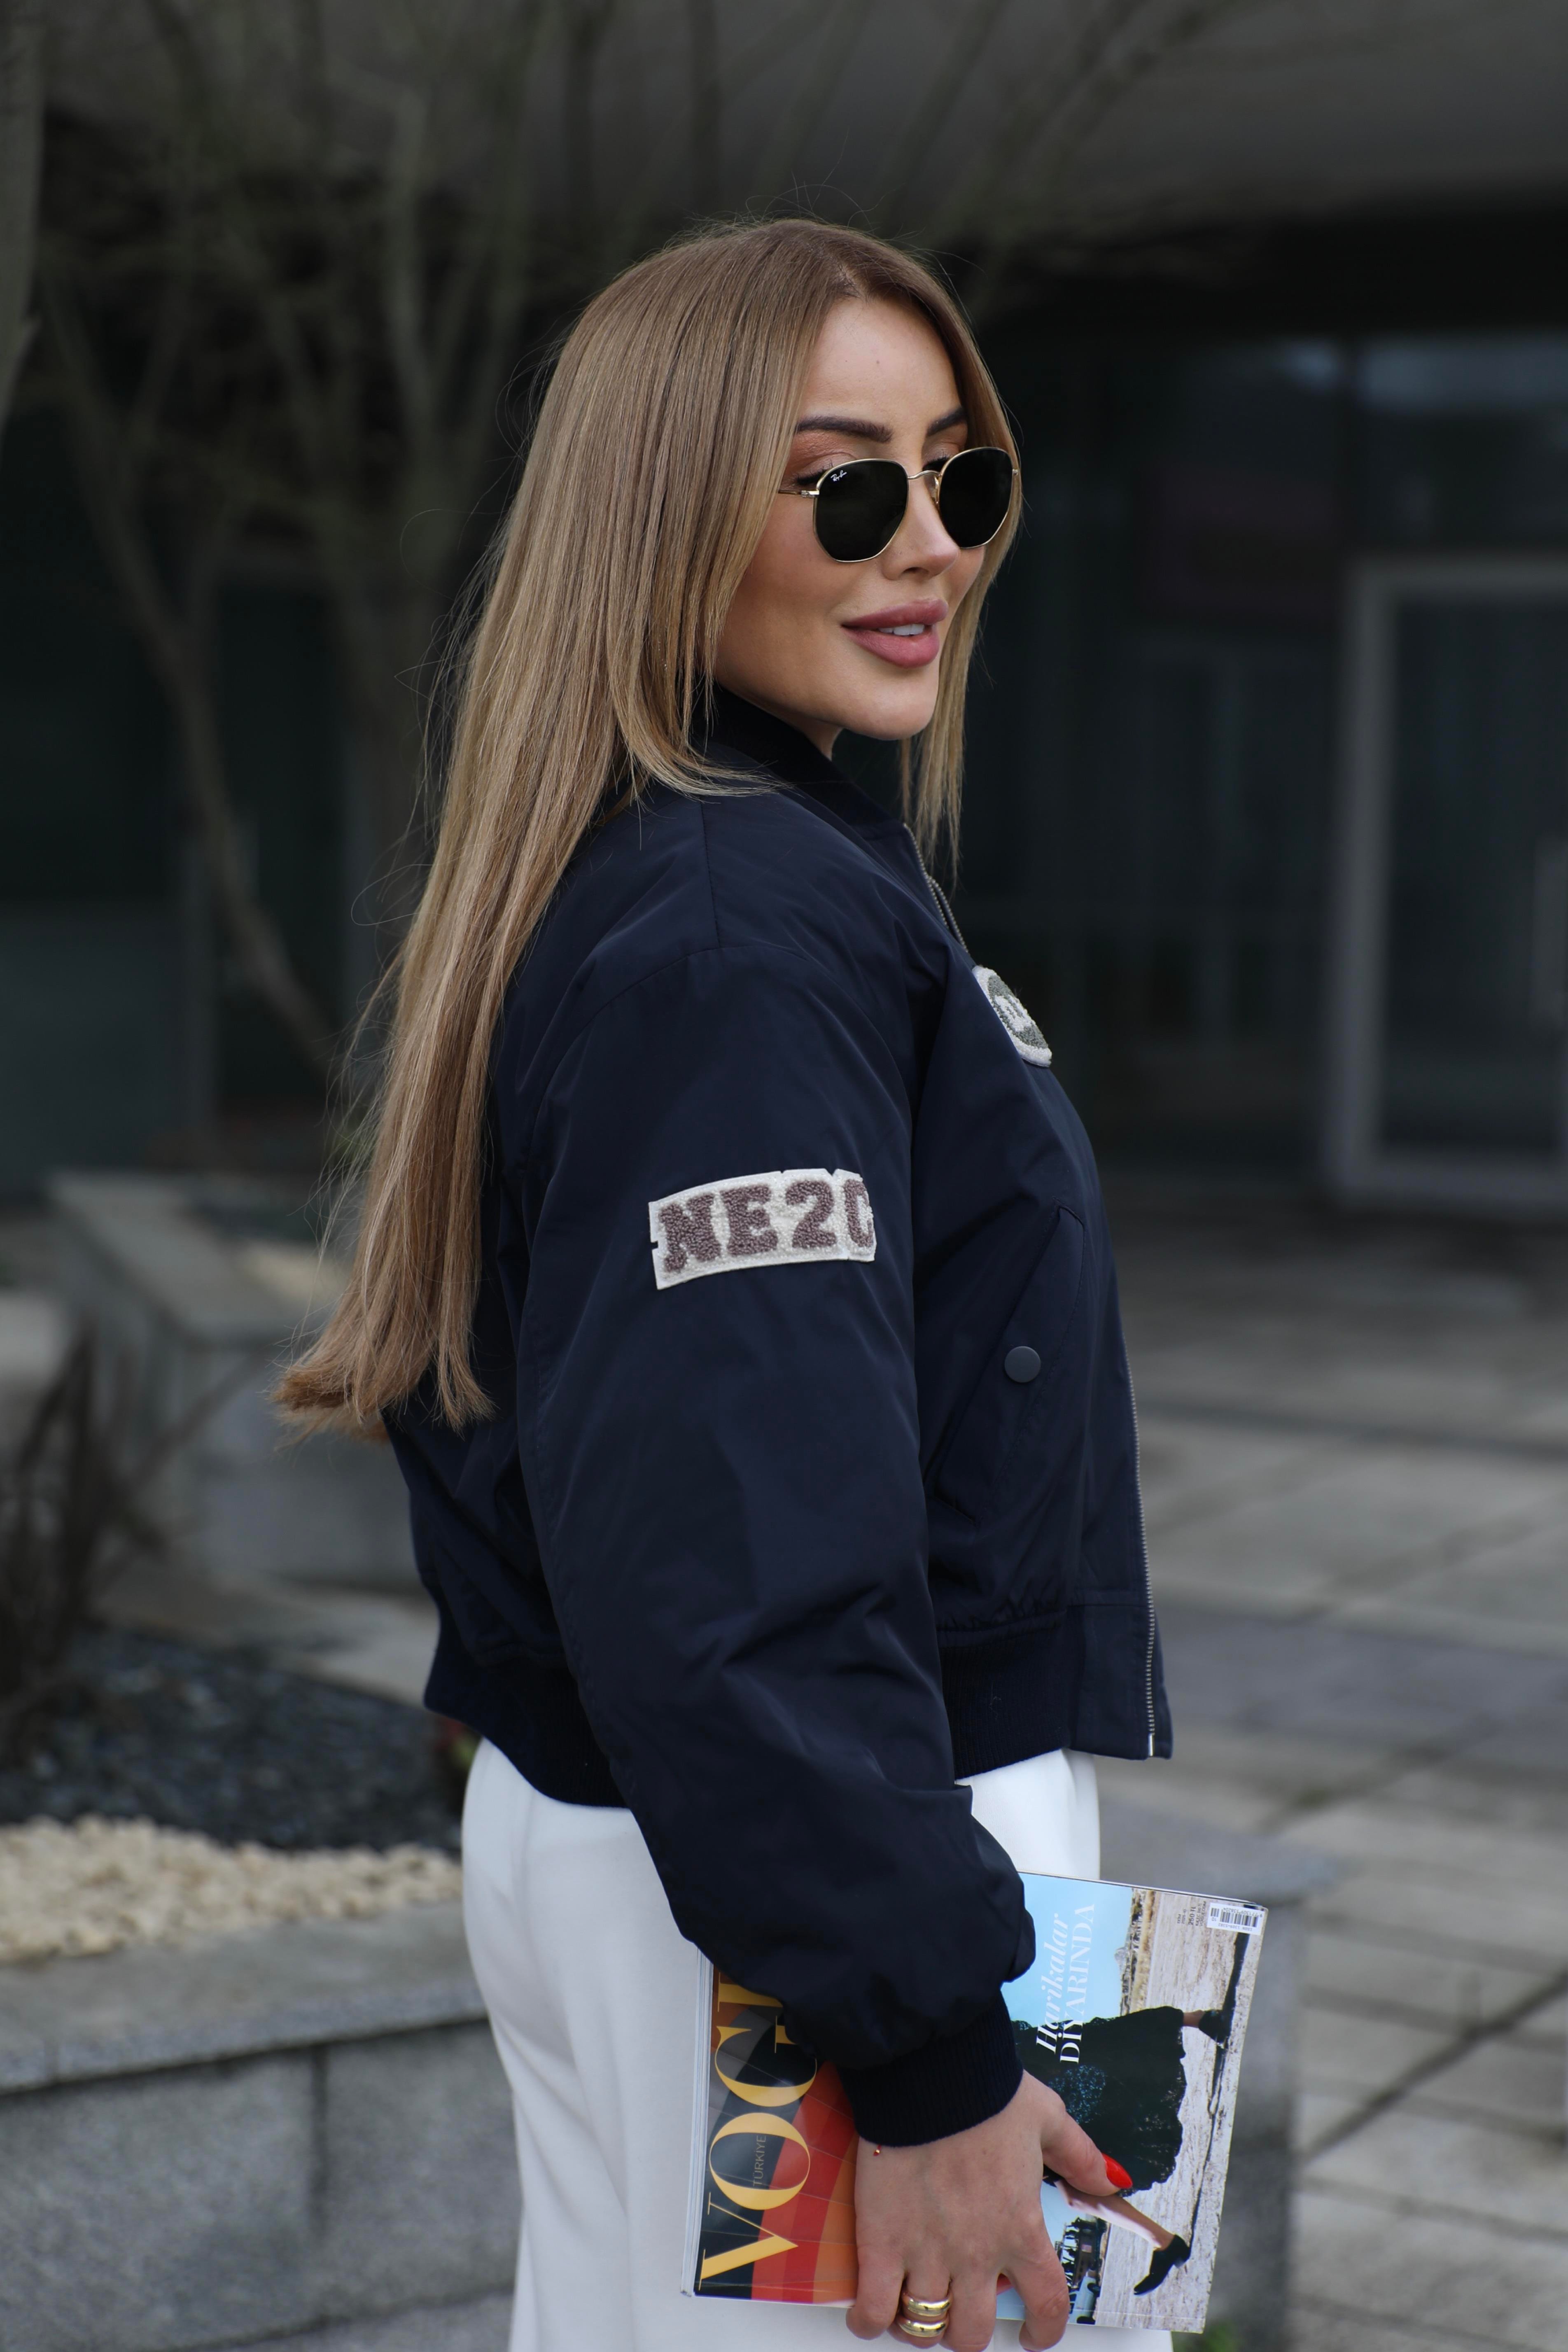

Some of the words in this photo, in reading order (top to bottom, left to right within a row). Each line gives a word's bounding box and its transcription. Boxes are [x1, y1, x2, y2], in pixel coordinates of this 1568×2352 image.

[1036, 1913, 1068, 2054] Harikalar
[1059, 1904, 1095, 2064] DİYARINDA
[752, 2135, 767, 2188] TÜRKİYE
